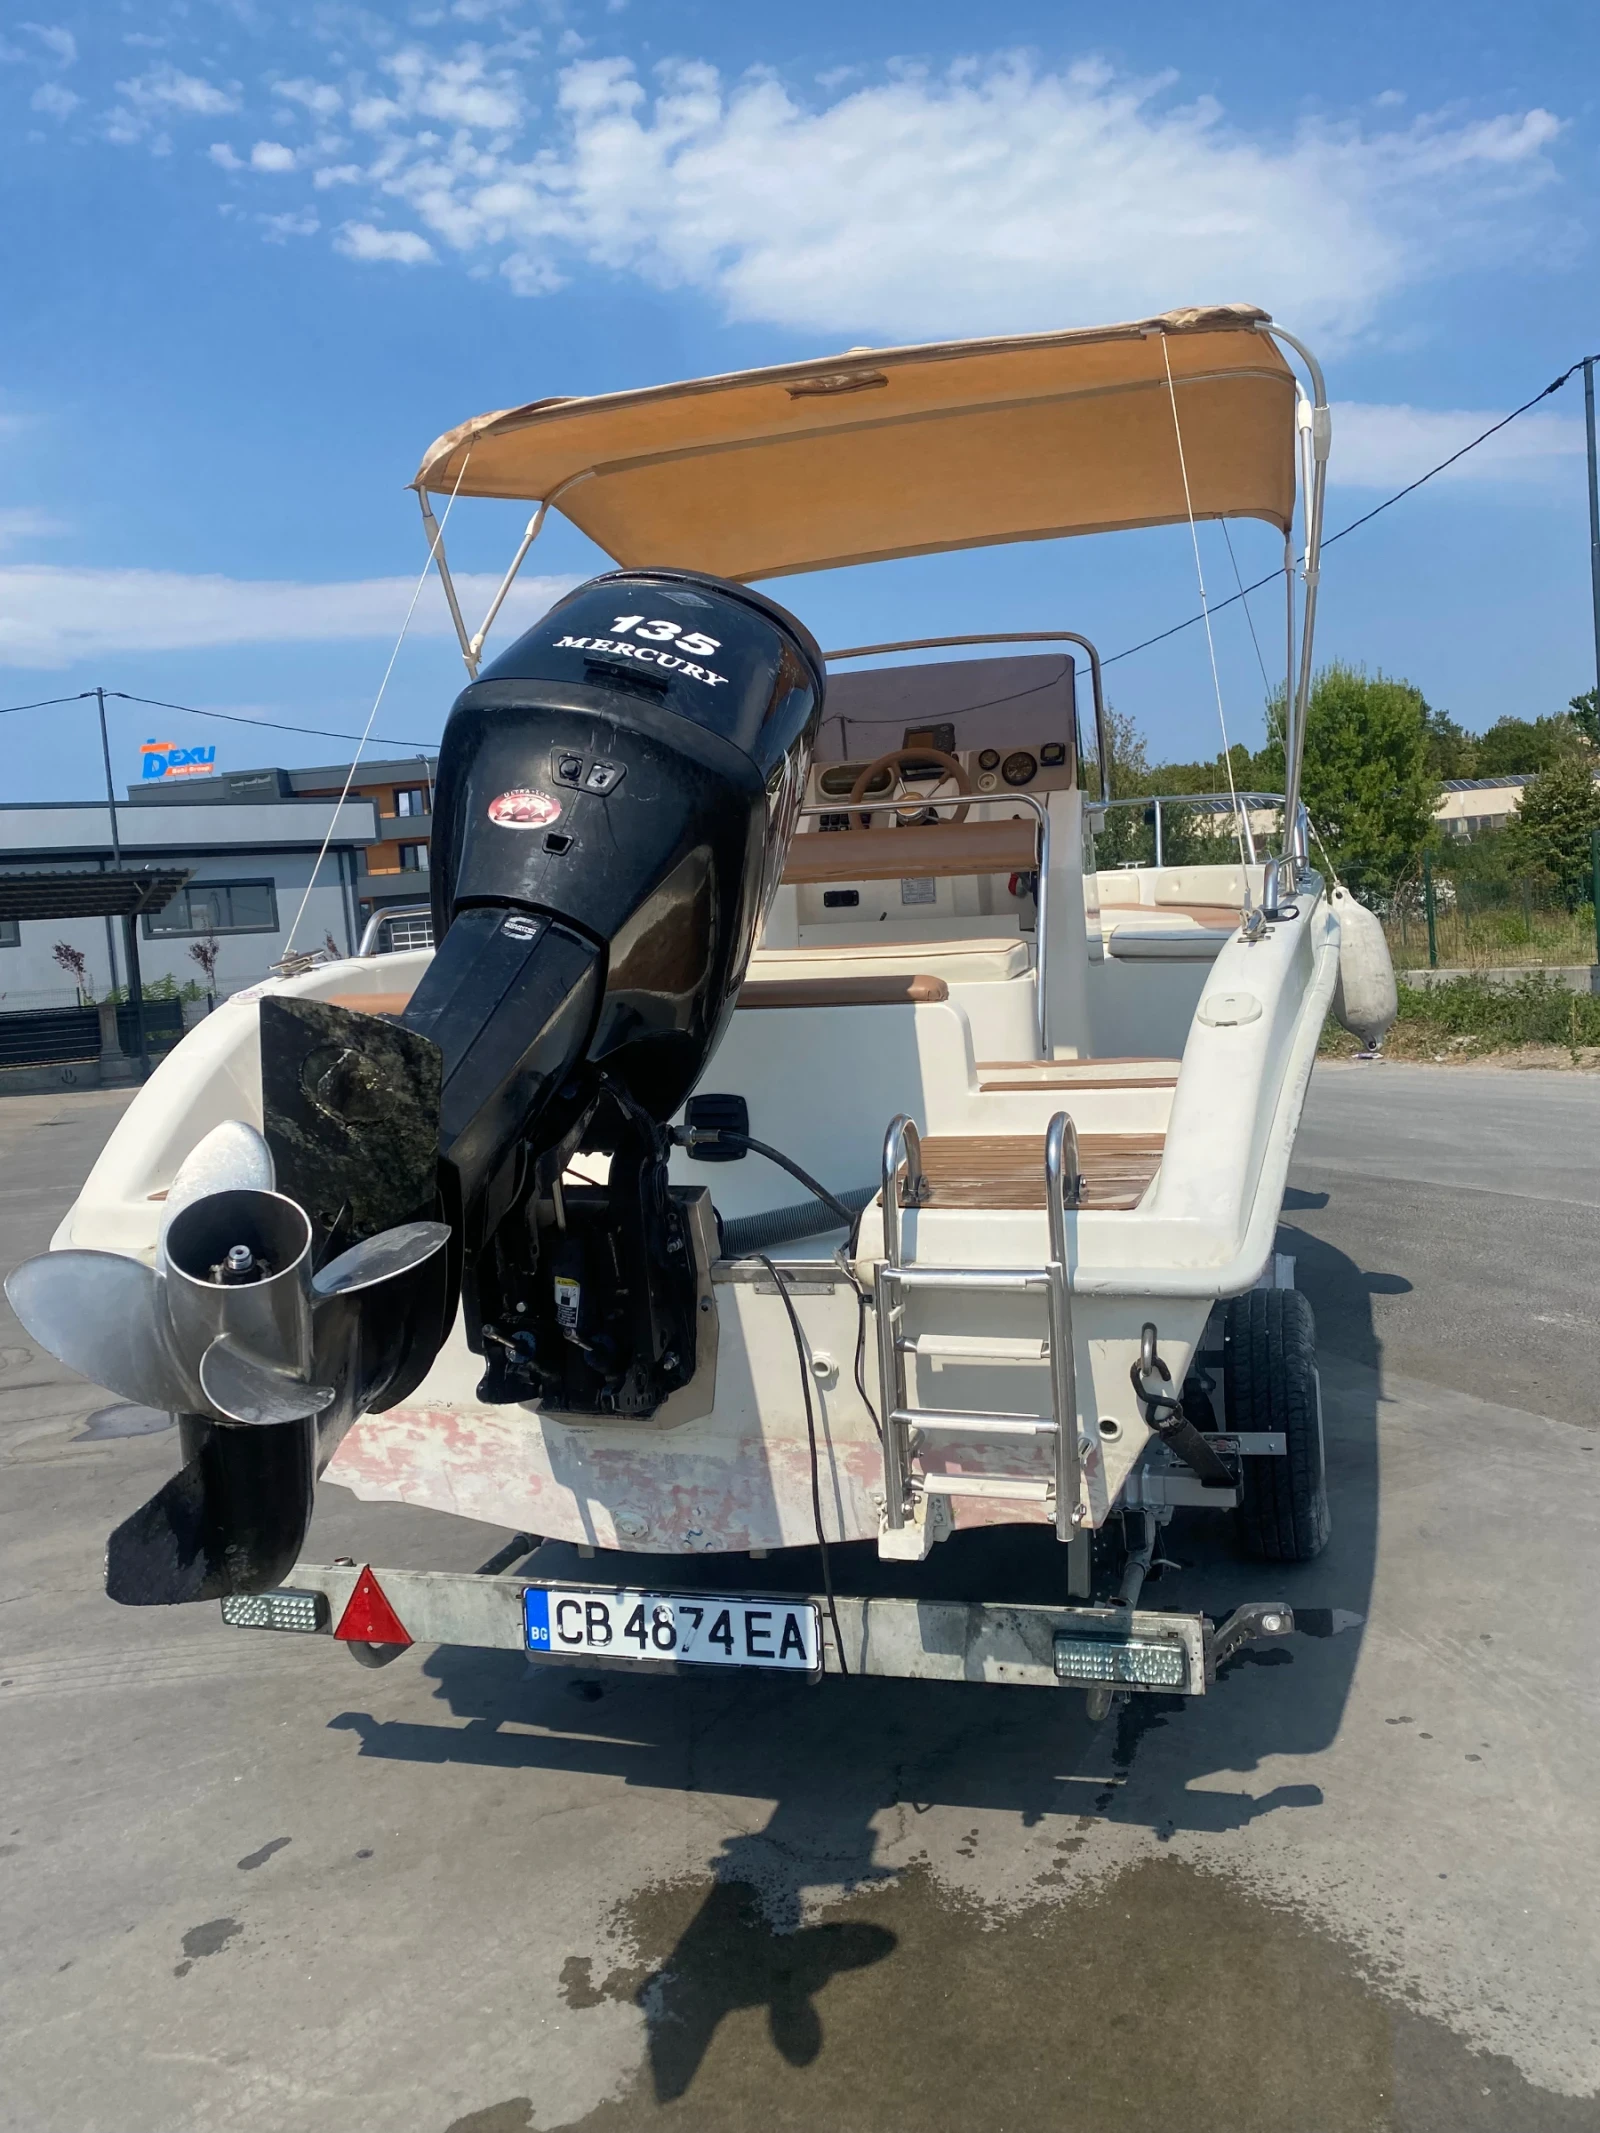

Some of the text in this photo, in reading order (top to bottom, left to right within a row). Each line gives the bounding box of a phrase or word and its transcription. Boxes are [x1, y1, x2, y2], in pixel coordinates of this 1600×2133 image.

[610, 615, 722, 656] 135
[552, 636, 729, 686] MERCURY
[142, 745, 216, 778] DEXU
[531, 1626, 548, 1641] BG
[556, 1599, 808, 1660] CB 4874 EA
